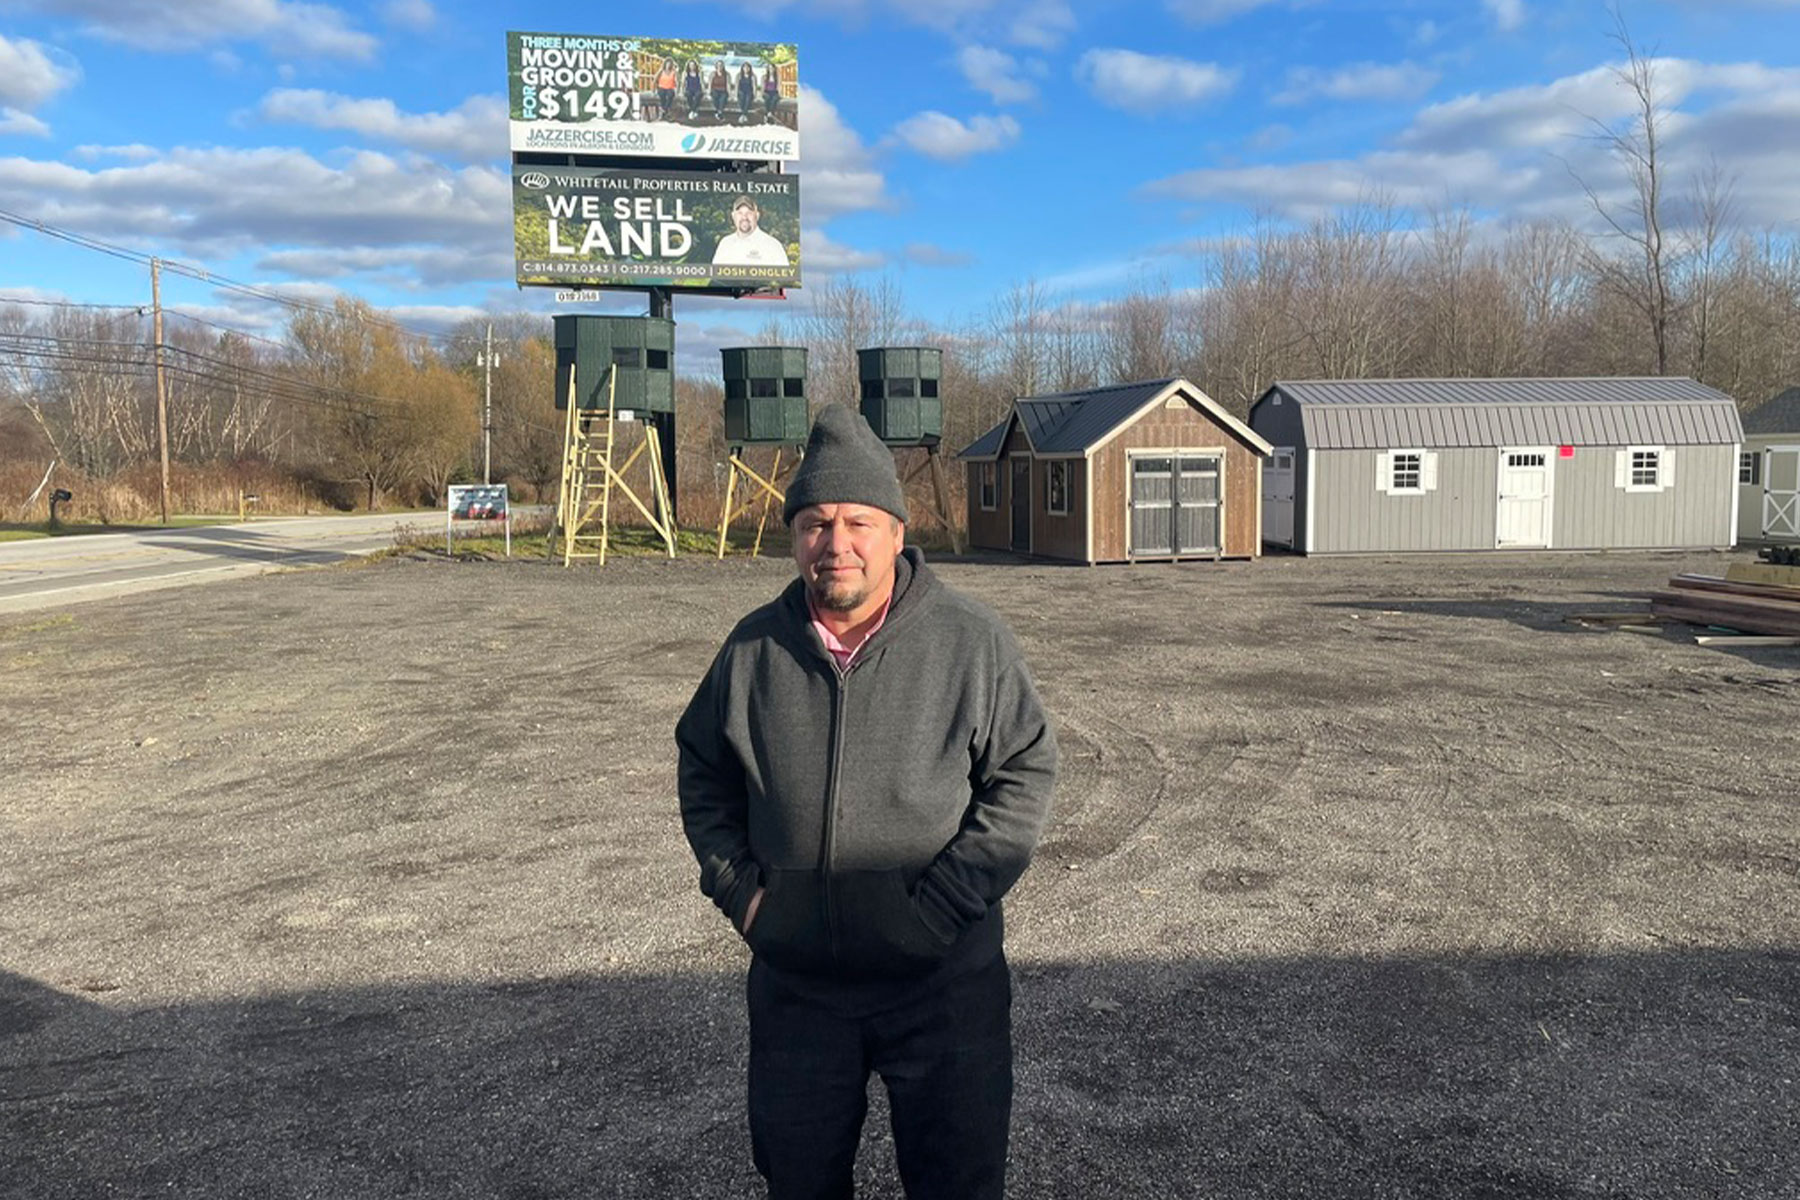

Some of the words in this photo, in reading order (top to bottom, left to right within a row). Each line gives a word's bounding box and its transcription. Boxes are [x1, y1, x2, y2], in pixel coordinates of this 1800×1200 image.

[520, 35, 562, 49] THREE
[564, 37, 620, 51] MONTHS
[622, 40, 641, 52] OF
[521, 48, 610, 69] MOVIN'
[616, 51, 634, 70] &
[522, 85, 537, 119] FOR
[539, 85, 641, 120] $149!
[526, 129, 653, 144] JAZZERCISE.COM
[708, 137, 791, 155] JAZZERCISE
[554, 175, 630, 189] WHITETAIL
[633, 178, 708, 191] PROPERTIES
[713, 180, 743, 193] REAL
[747, 181, 790, 194] ESTATE
[545, 194, 600, 219] WE
[613, 197, 693, 221] SELL
[548, 219, 692, 257] LAND
[717, 267, 747, 277] JOSH
[749, 268, 796, 277] ONGLEY
